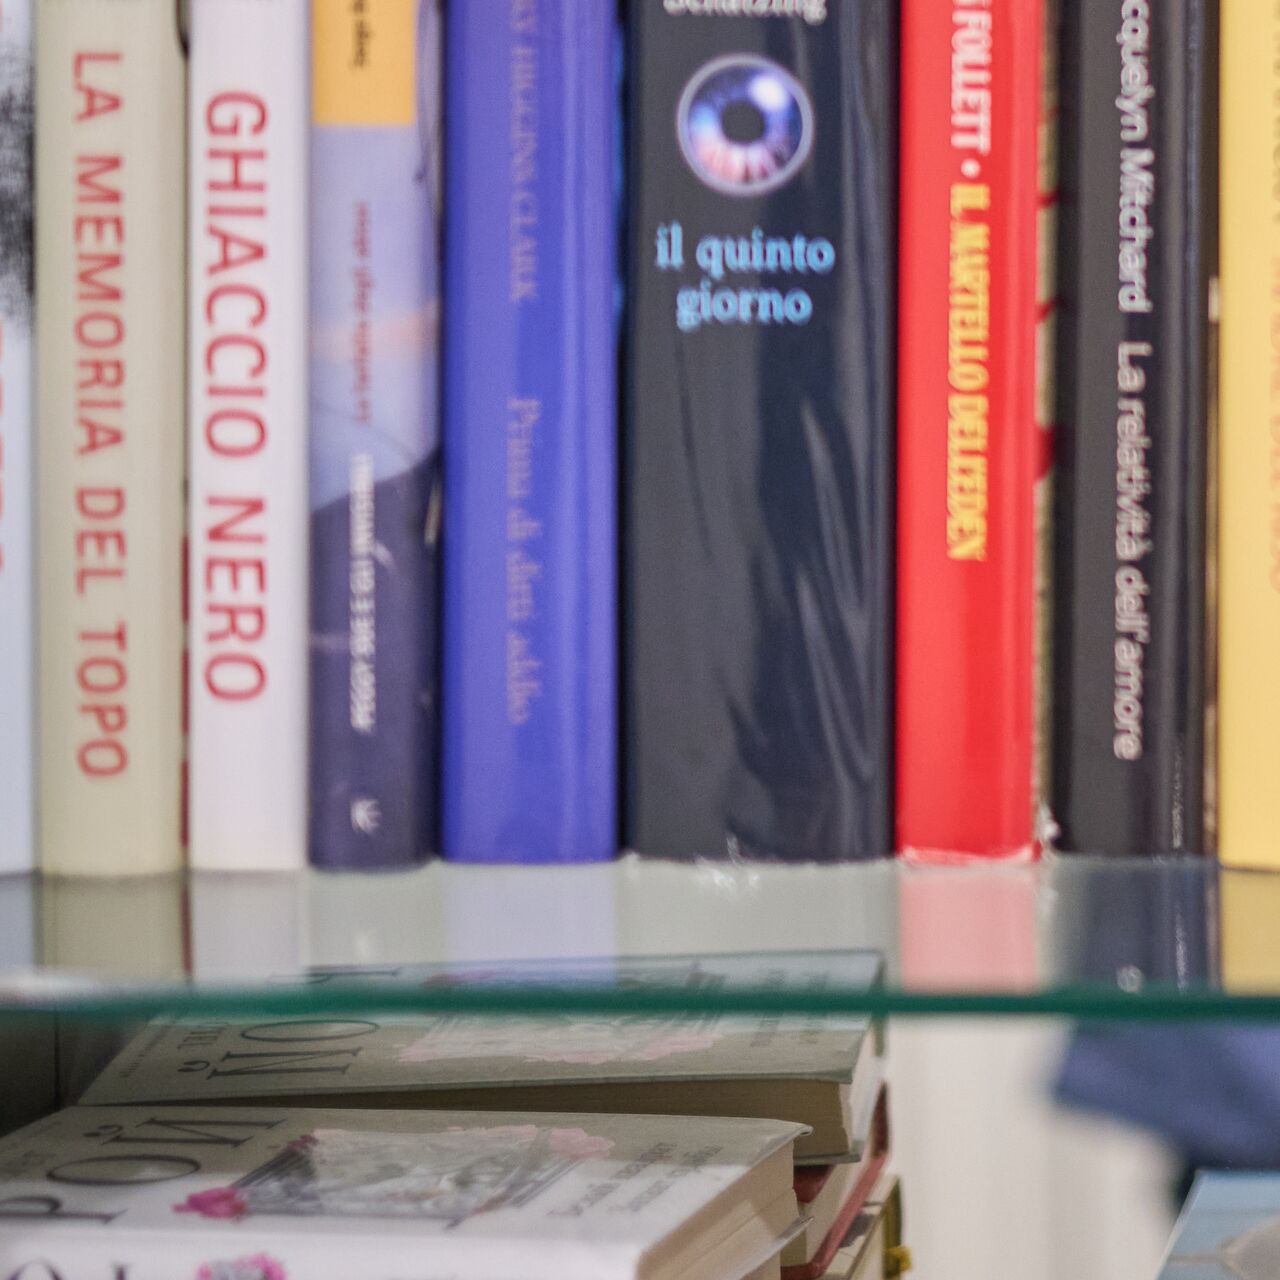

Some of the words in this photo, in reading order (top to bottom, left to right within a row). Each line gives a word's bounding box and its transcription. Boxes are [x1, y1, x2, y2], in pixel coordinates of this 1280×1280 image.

[73, 49, 124, 123] LA
[950, 8, 992, 155] FOLLETT
[205, 91, 267, 458] GHIACCIO
[655, 221, 685, 270] il
[696, 225, 836, 280] quinto
[949, 182, 989, 221] IL
[1117, 149, 1153, 313] Mitchard
[74, 154, 125, 457] MEMORIA
[676, 280, 813, 331] giorno
[948, 223, 989, 390] MARTELLO
[1117, 340, 1151, 393] La
[76, 486, 128, 595] DEL
[1115, 398, 1153, 561] relatività
[205, 494, 267, 702] NERO
[1111, 567, 1150, 760] dell'amore
[77, 620, 130, 778] TOPO
